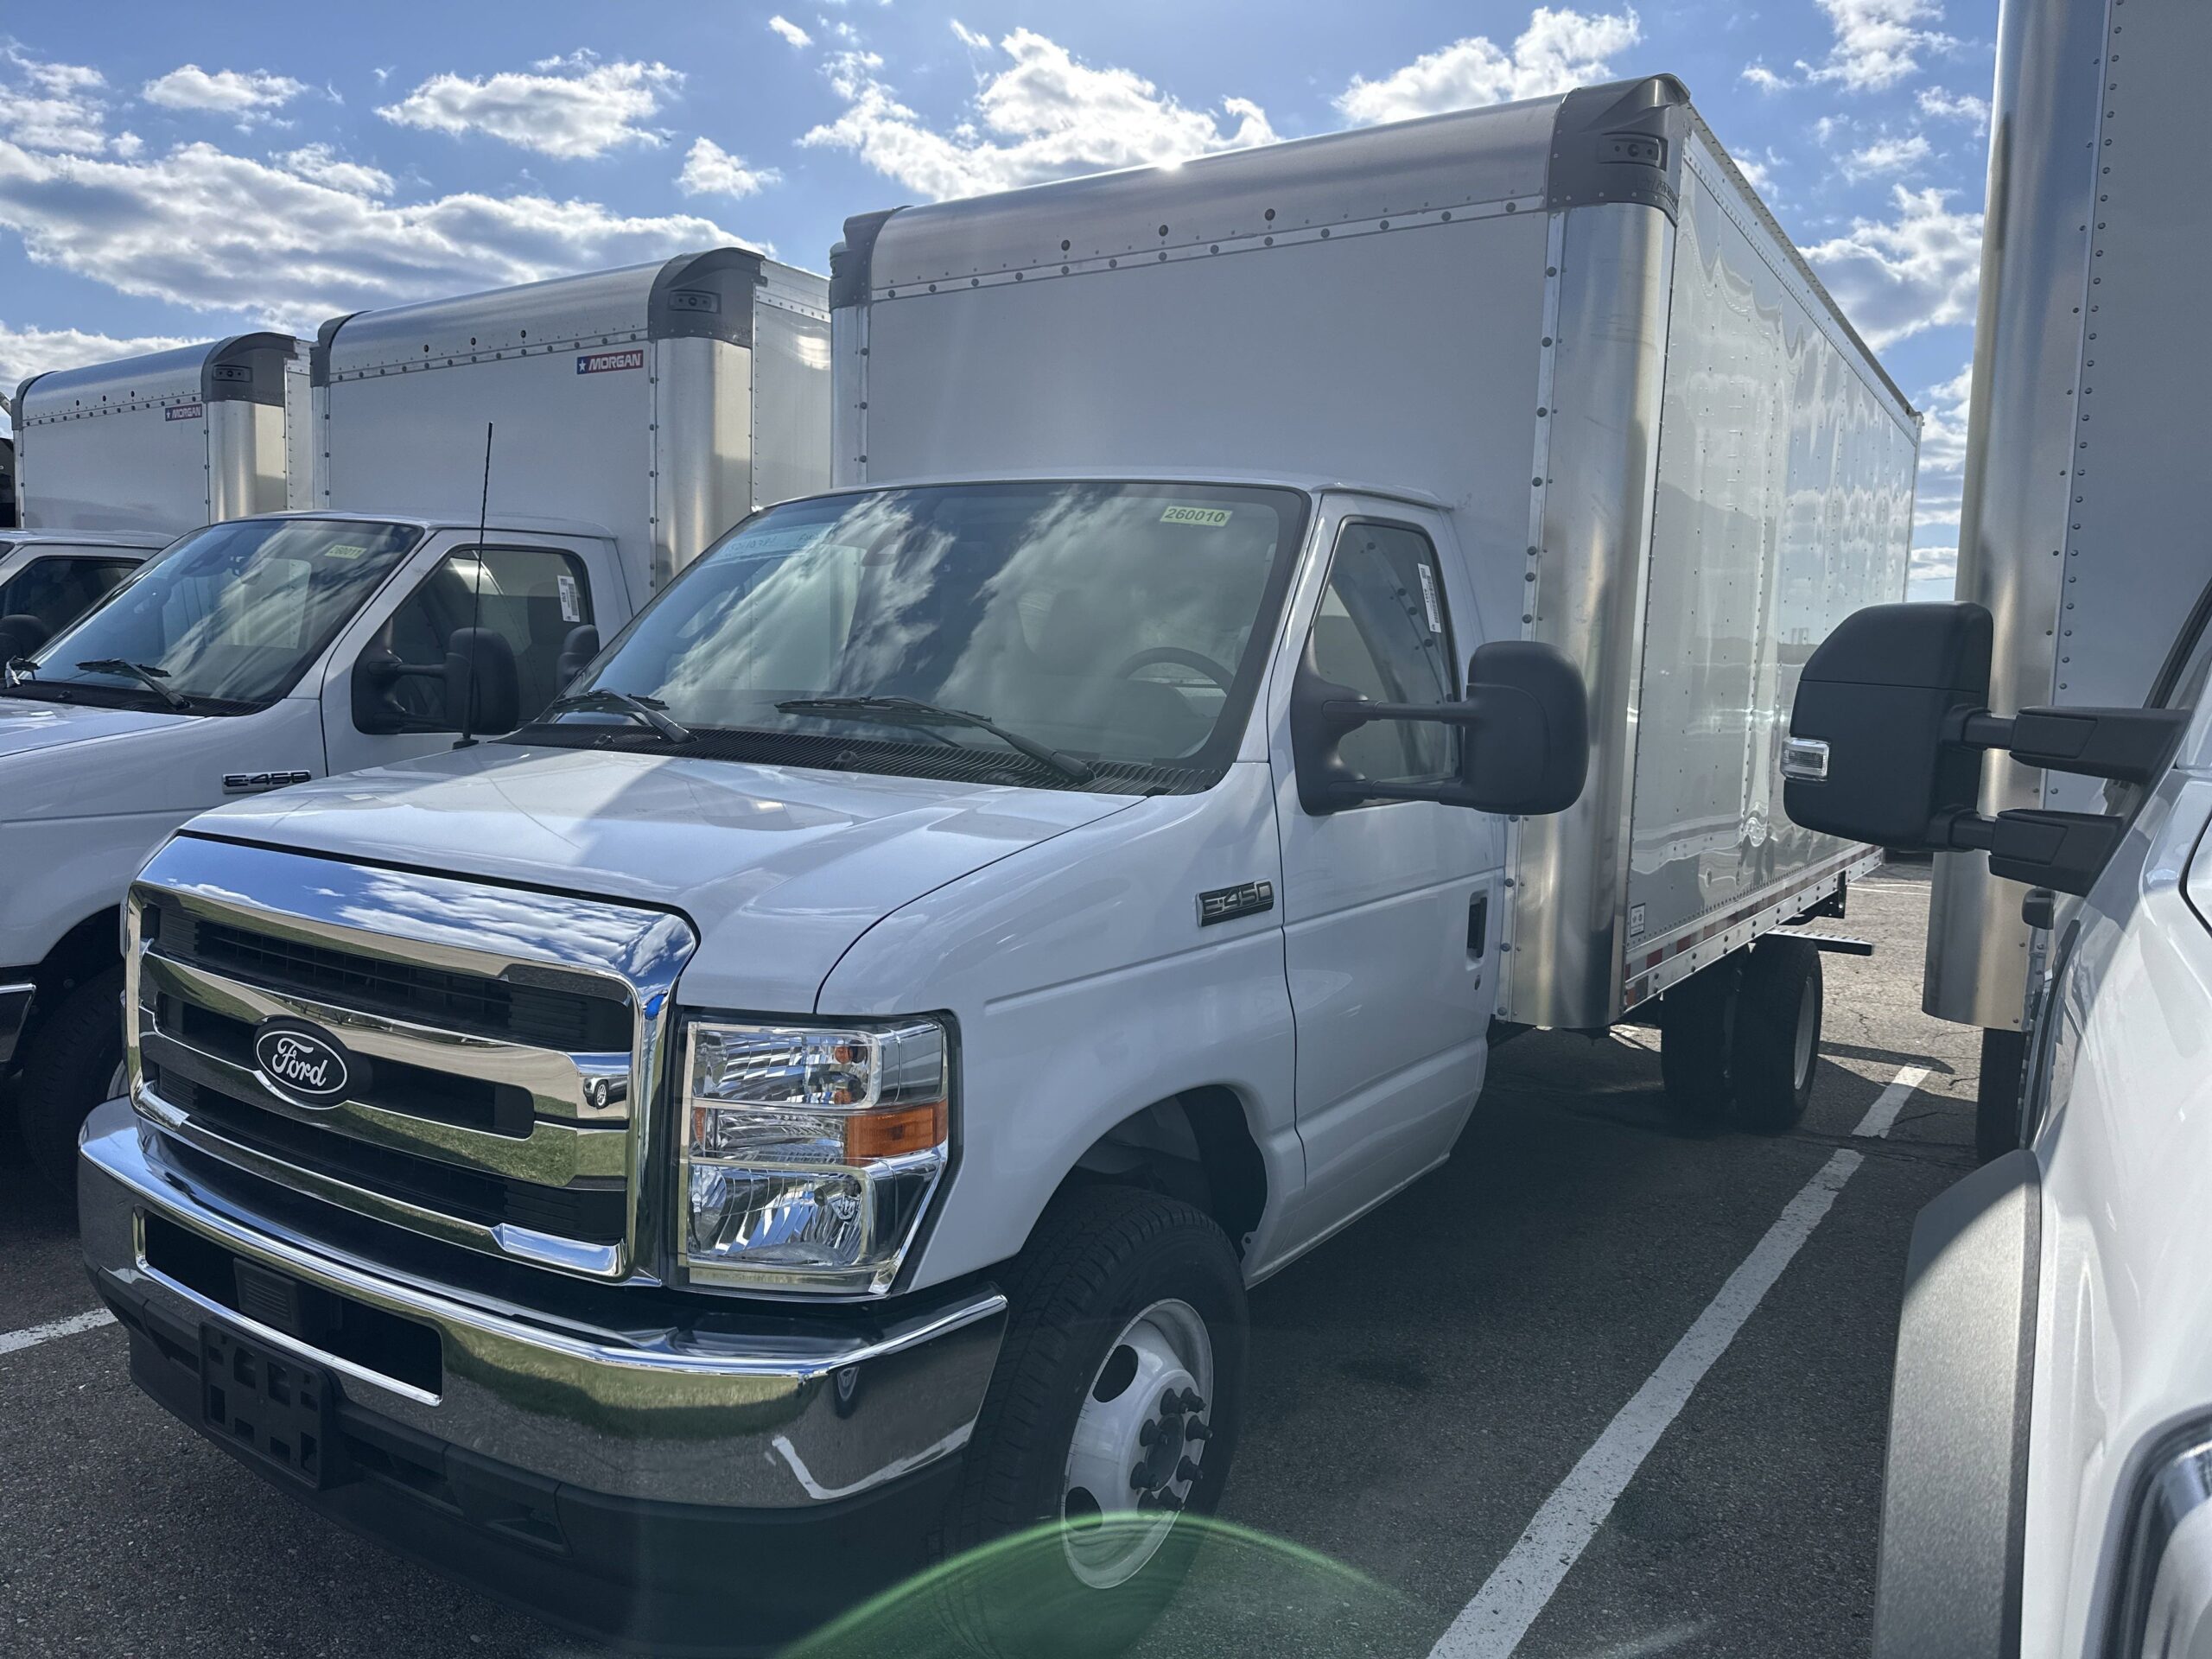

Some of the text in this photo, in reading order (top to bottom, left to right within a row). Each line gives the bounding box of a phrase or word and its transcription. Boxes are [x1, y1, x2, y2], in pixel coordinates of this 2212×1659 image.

[588, 353, 642, 372] MORGAN
[172, 406, 201, 419] MORGAN
[1165, 507, 1225, 523] 260010
[1199, 880, 1273, 915] E-450
[271, 1037, 328, 1087] Ford
